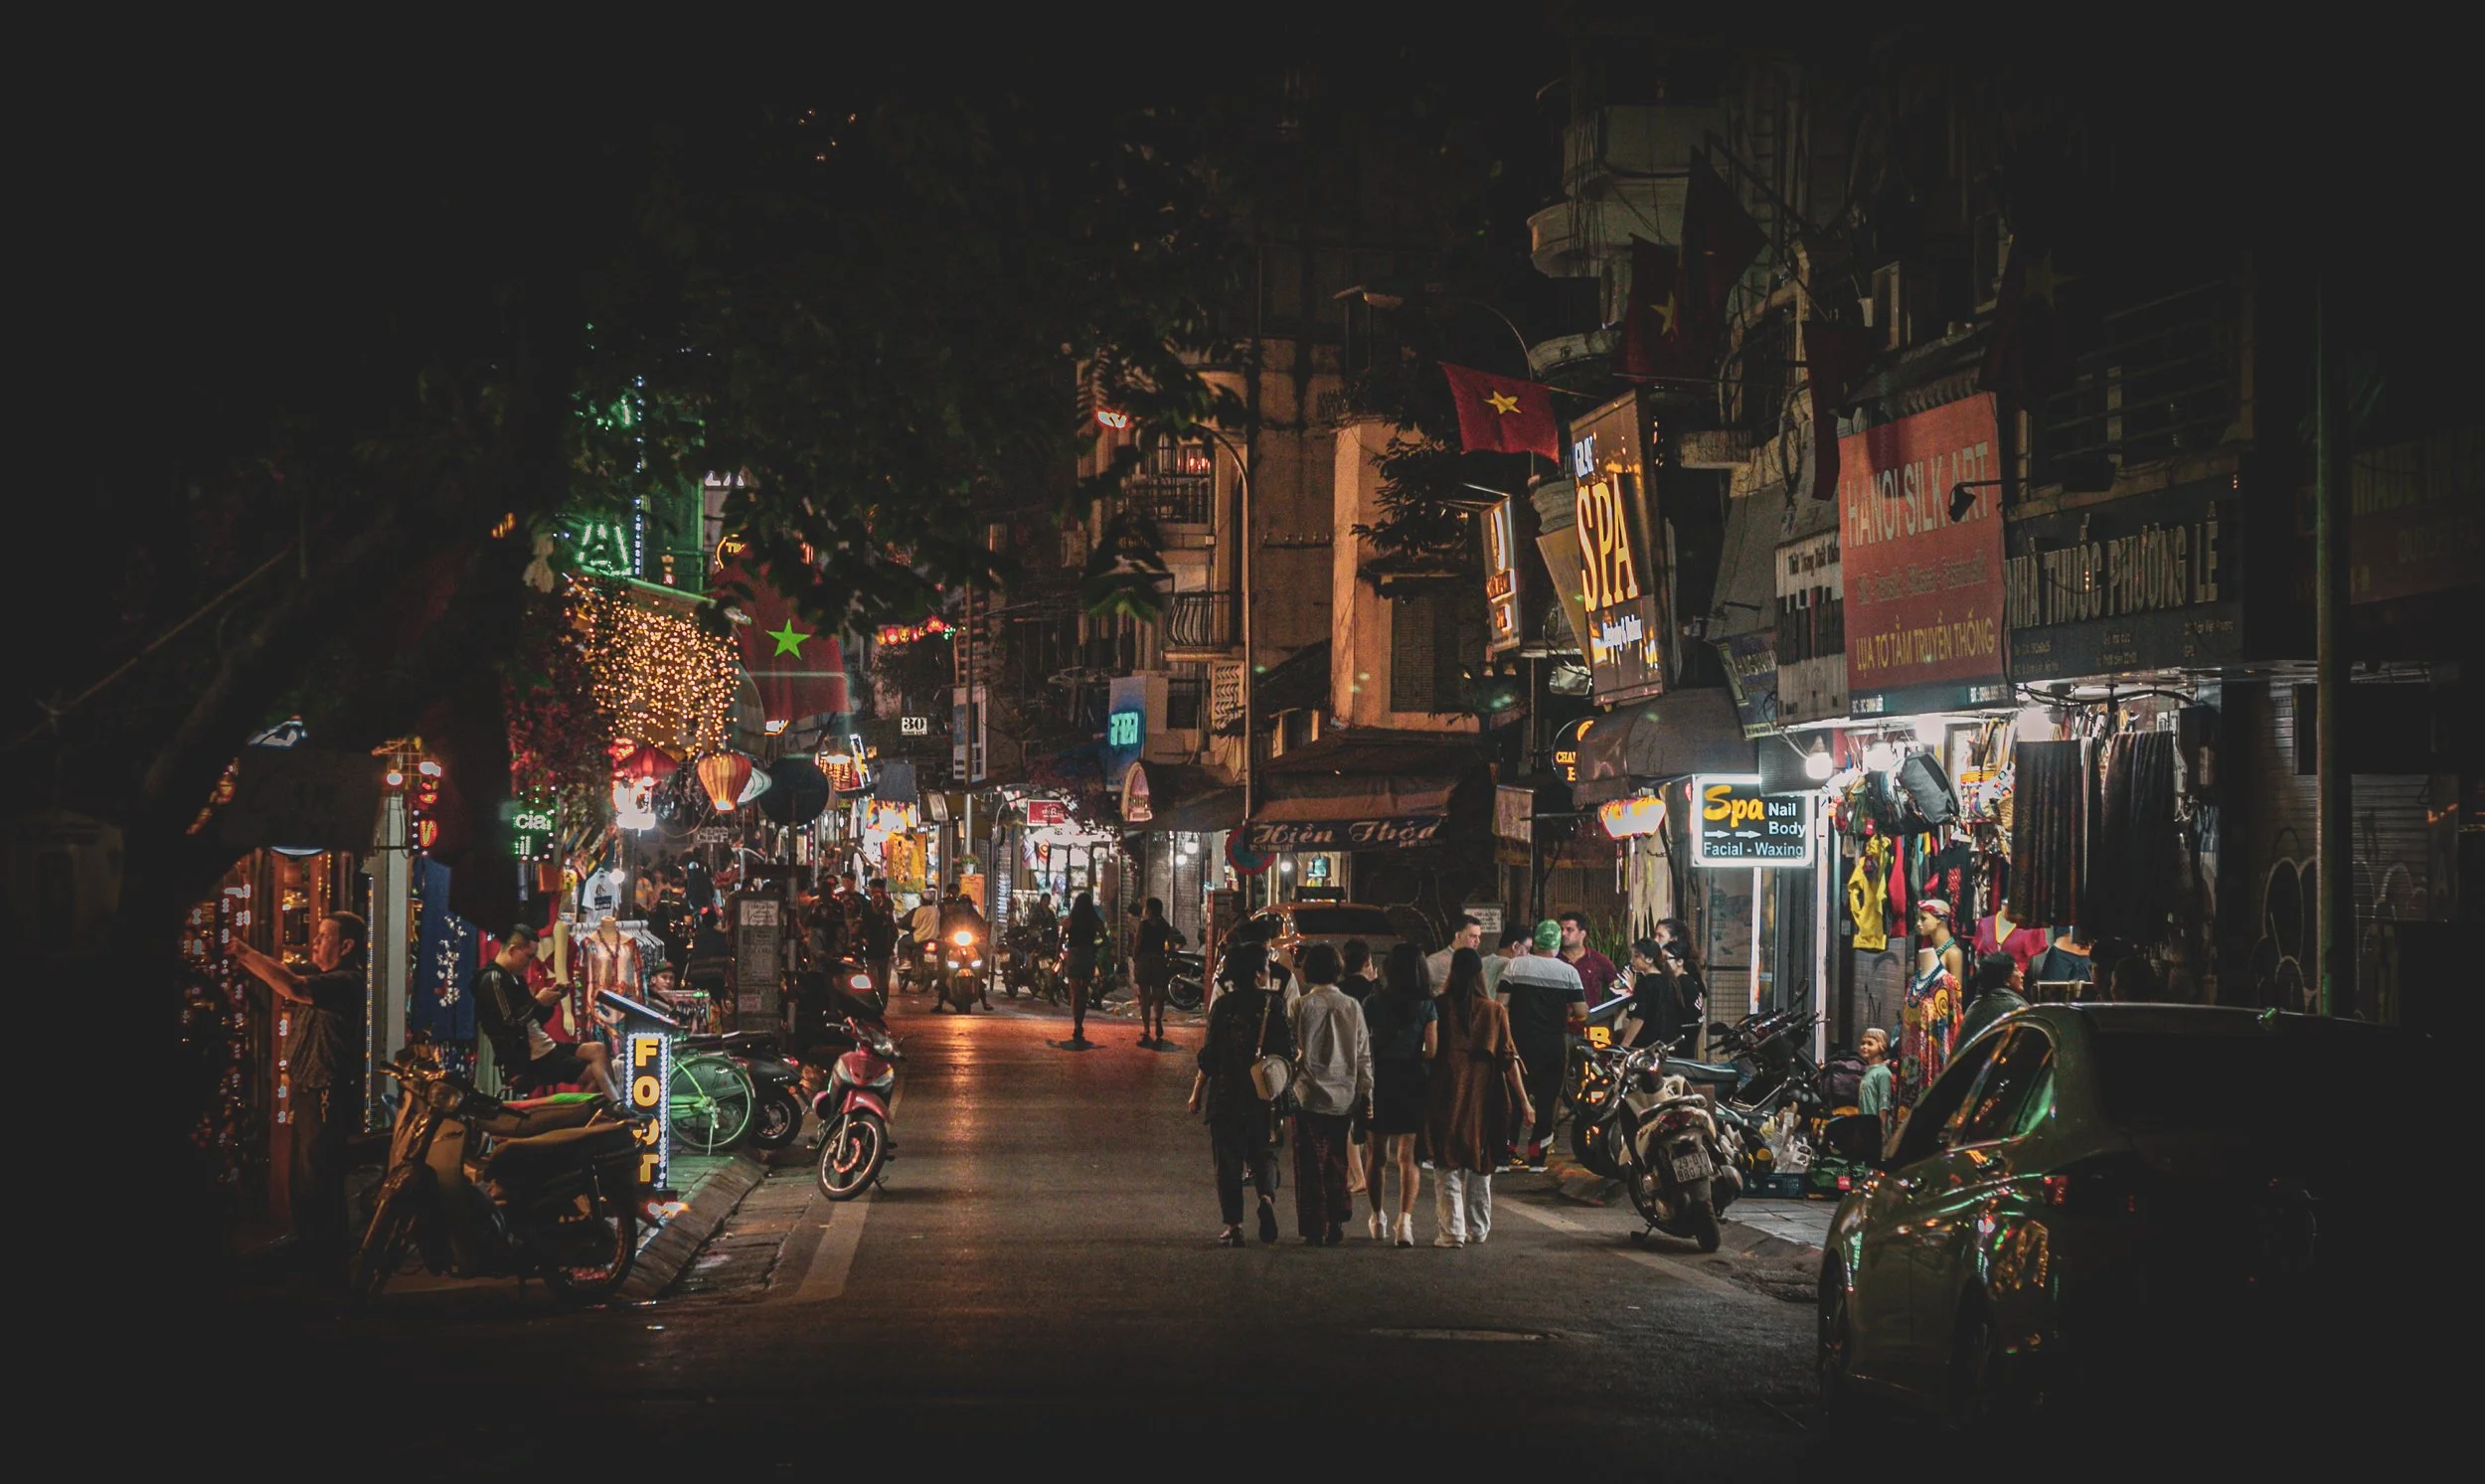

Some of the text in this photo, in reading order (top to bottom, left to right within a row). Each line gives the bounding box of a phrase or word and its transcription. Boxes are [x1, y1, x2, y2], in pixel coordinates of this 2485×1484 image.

[1847, 441, 1989, 549] HANOI SILK ART
[1576, 473, 1638, 612] SPA
[2004, 536, 2040, 629] NHÀ
[2044, 514, 2103, 625] THUỐC
[2107, 522, 2187, 616] PHƯƠNG
[1856, 635, 1875, 679] LỤA
[1913, 607, 1953, 664] TRUYỀN
[1954, 604, 1996, 658] THỐNG
[904, 717, 924, 731] 30
[1703, 784, 1796, 829] Spa Nail
[1768, 821, 1807, 838] Body
[1703, 843, 1742, 856] Facial
[1754, 842, 1805, 859] Waxing
